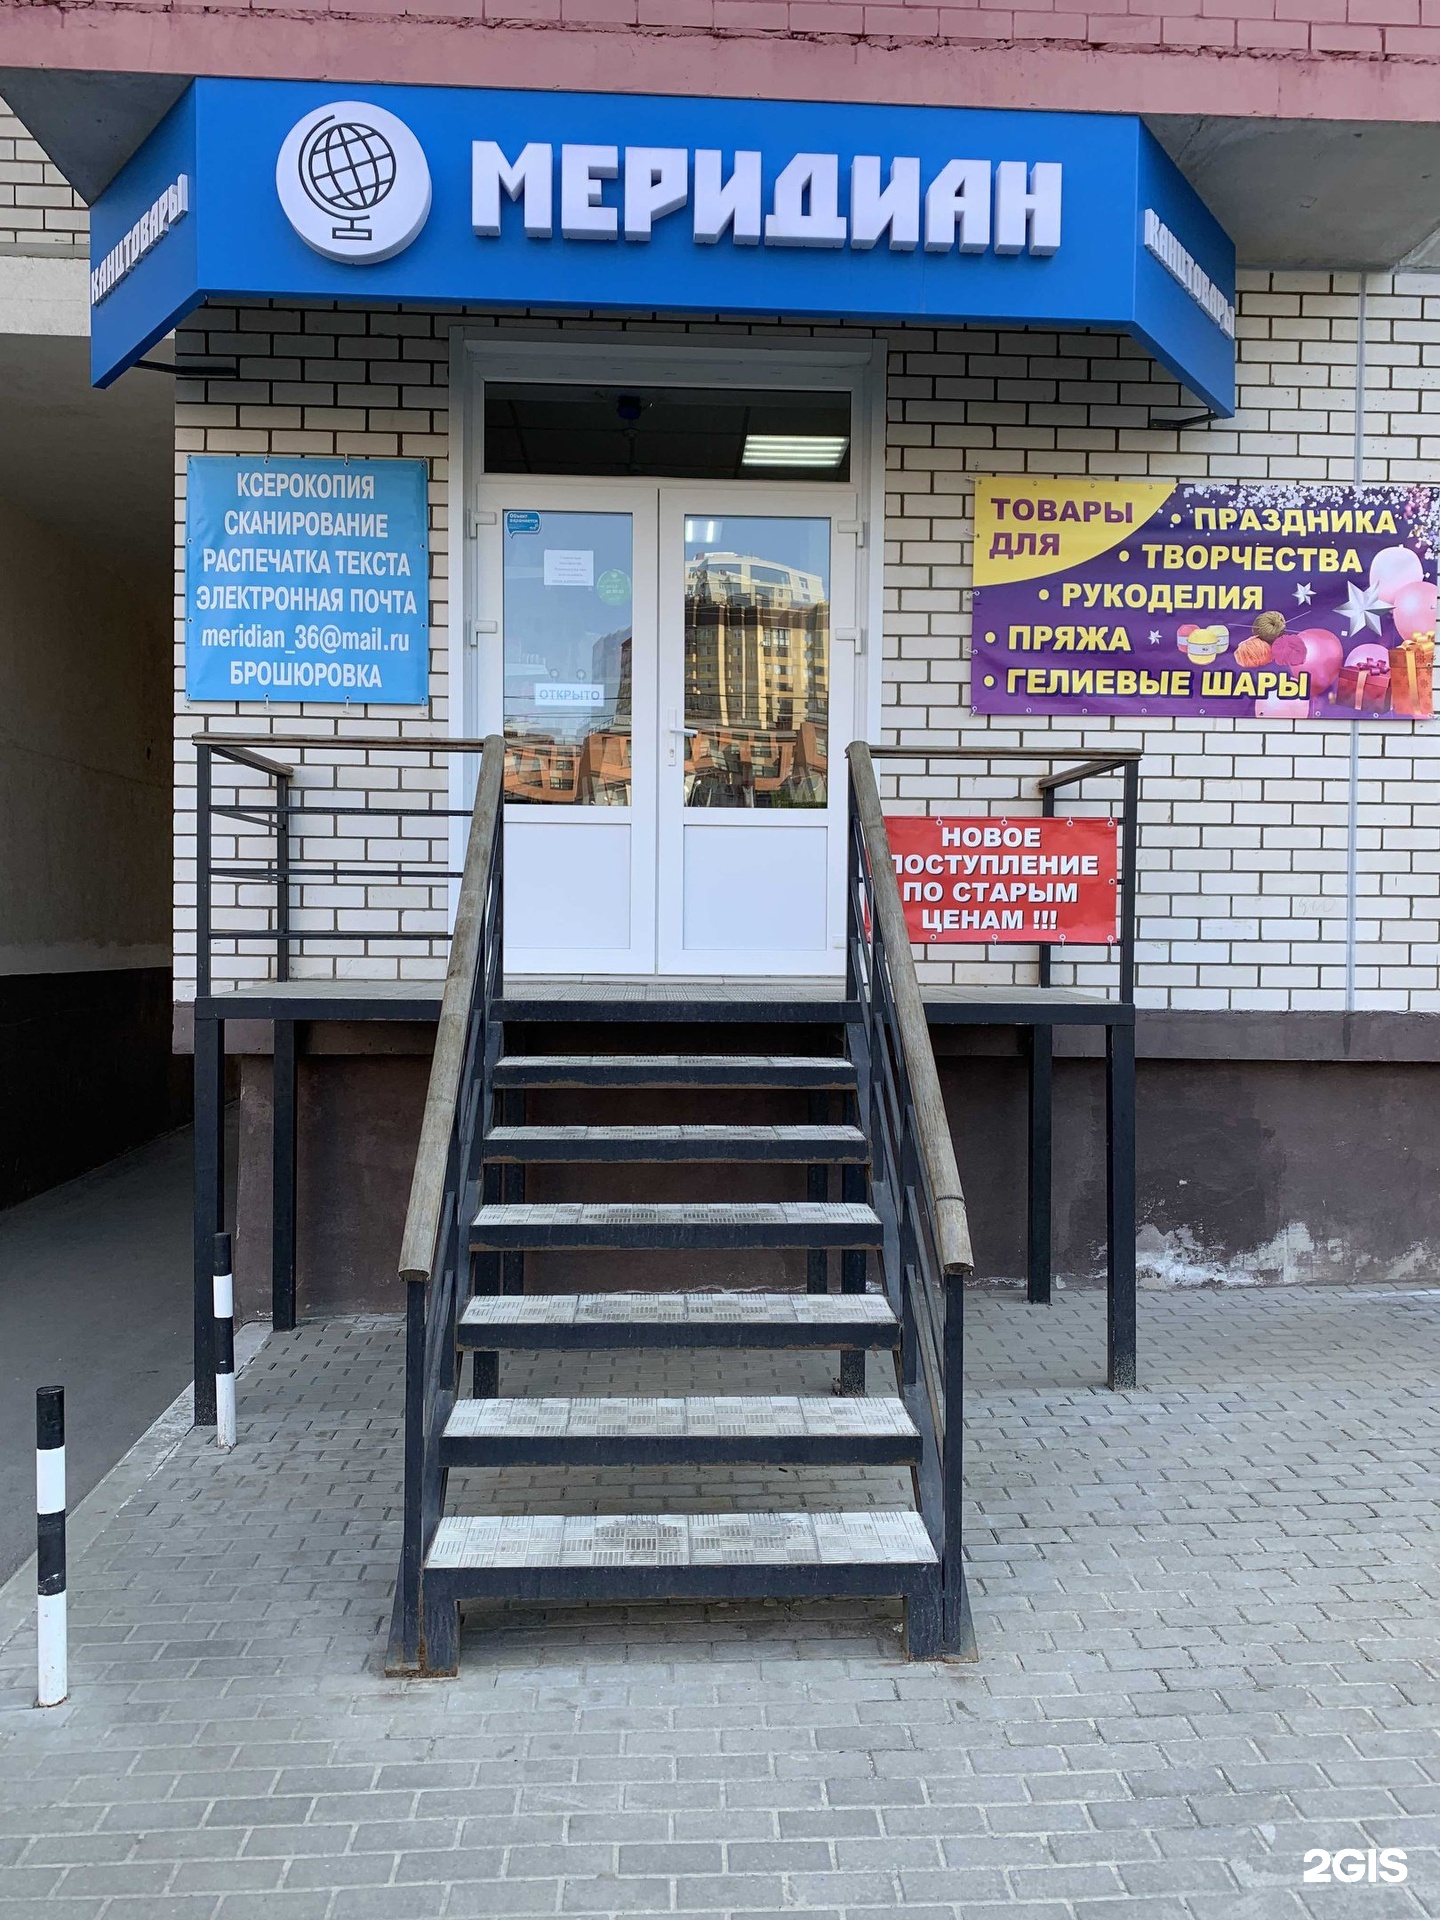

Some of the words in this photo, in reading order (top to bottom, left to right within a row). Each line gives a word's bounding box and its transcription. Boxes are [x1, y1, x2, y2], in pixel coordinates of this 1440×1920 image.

[471, 140, 1062, 256] МЕРИДИАН
[91, 173, 188, 306] КАНЦТОВАРЫ
[1145, 208, 1235, 340] КАНЦТОВАРЫ
[237, 472, 375, 499] КСЕРОКОПИЯ
[224, 511, 388, 538] СКАНИРОВАНИЕ
[990, 497, 1133, 524] ТОВАРЫ
[1194, 507, 1397, 536] ПРАЗДНИКА
[988, 532, 1060, 560] ДЛЯ
[1142, 543, 1363, 573] ТВОРЧЕСТВА
[203, 548, 331, 574] РАСПЕЧАТКА
[336, 550, 411, 576] ТЕКСТА
[196, 586, 344, 612] ЭЛЕКТРОННАЯ
[350, 588, 417, 614] ПОЧТА
[1062, 583, 1264, 614] РУКОДЕЛИЯ
[201, 623, 409, 654] meridian_36@mail.ru
[1008, 625, 1131, 651] ПРЯЖА
[230, 661, 382, 688] БРОШЮРОВКА
[1007, 669, 1191, 696] ГЕЛИЕВЫЕ
[1201, 671, 1308, 697] ШАРЫ
[539, 689, 600, 701] ОТКРЫТО
[941, 827, 1041, 847] НОВОЕ
[903, 882, 943, 902] ПО
[952, 882, 1078, 903] СТАРЫМ
[922, 909, 1023, 933] ЦЕНАМ
[1032, 910, 1058, 930] !!!
